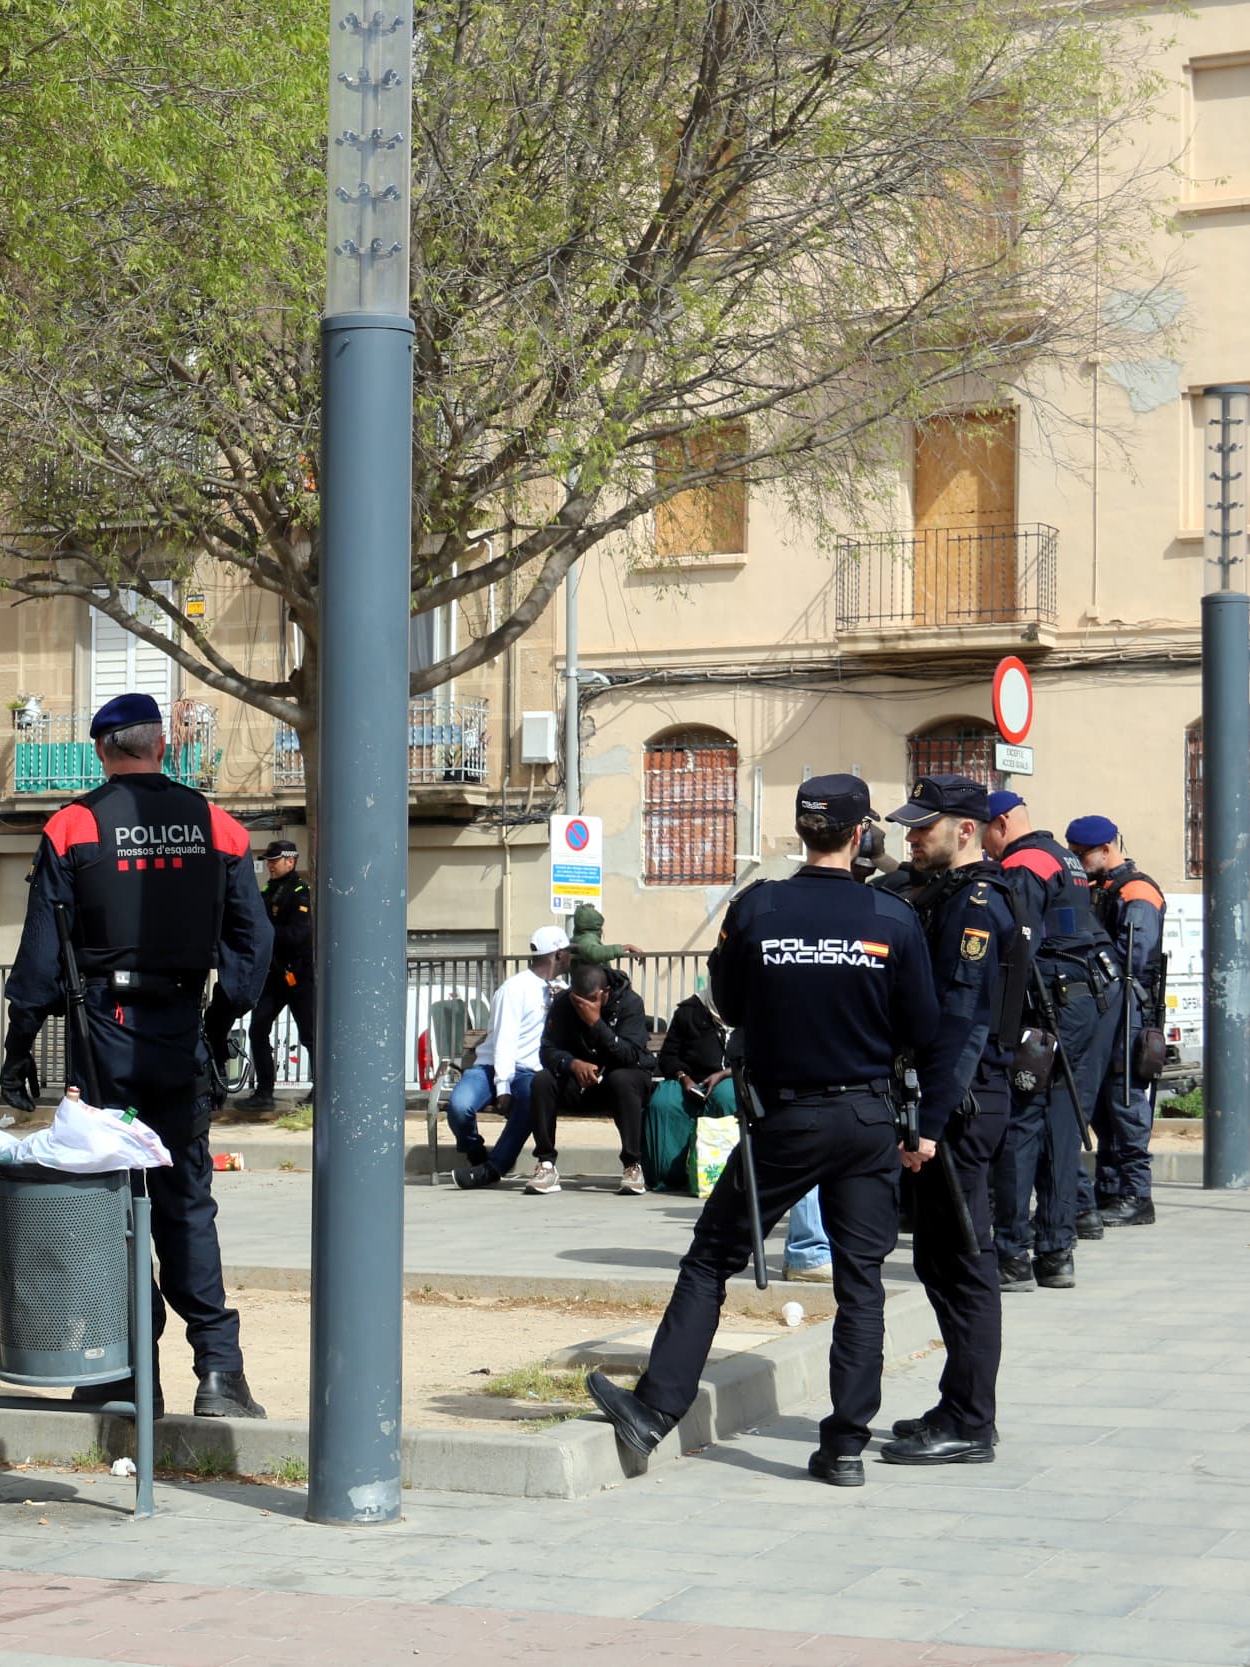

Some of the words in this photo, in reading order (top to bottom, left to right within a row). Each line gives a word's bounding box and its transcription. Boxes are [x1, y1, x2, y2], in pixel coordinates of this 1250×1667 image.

[115, 825, 205, 846] POLICIA
[117, 847, 154, 857] mossos
[763, 951, 885, 969] NACIONAL
